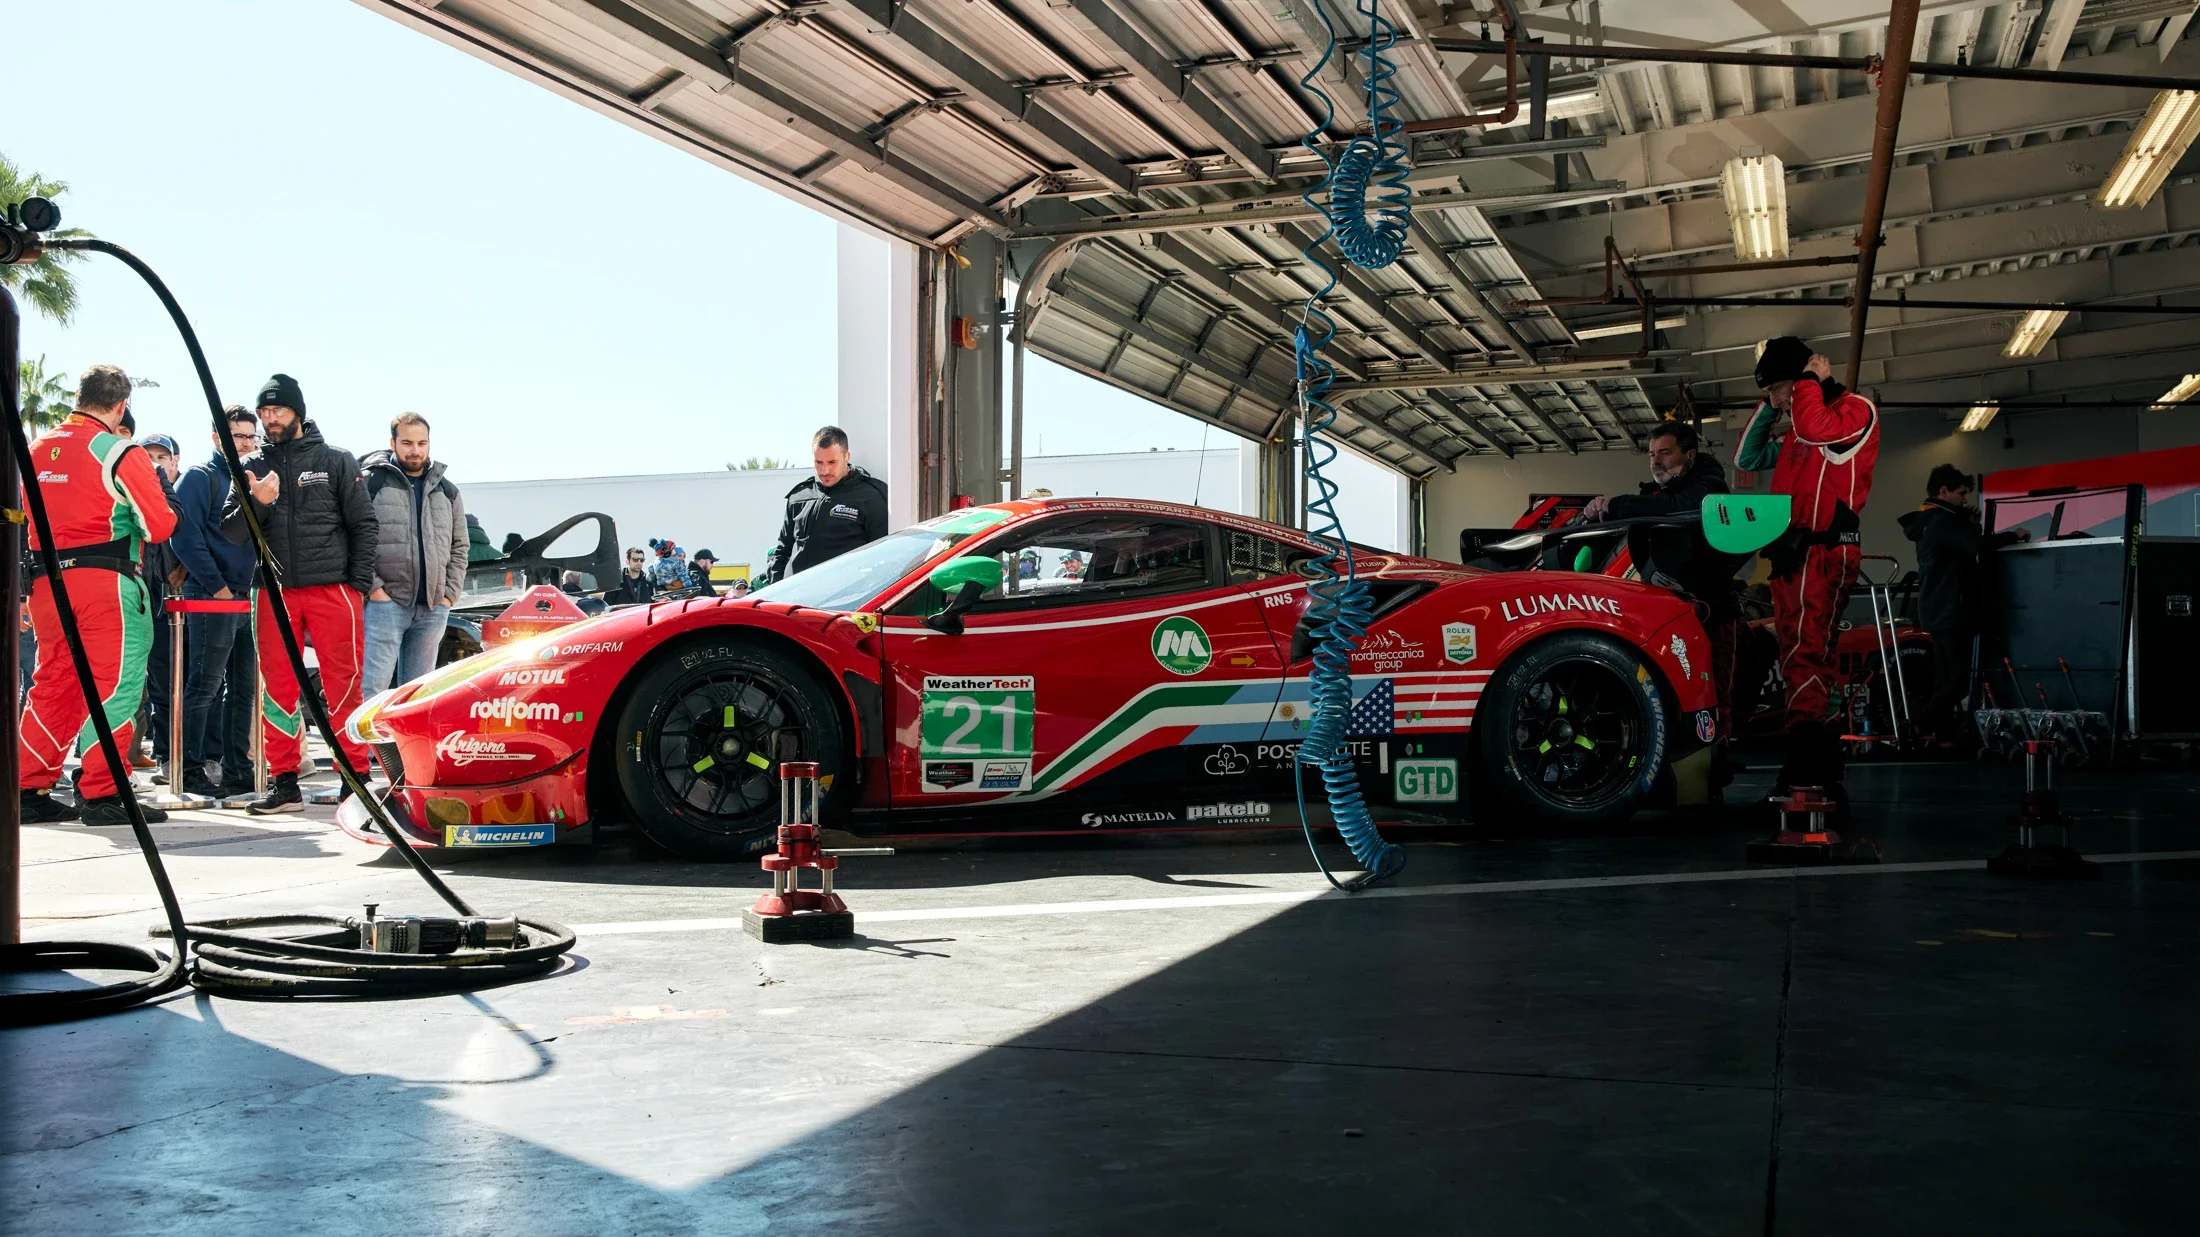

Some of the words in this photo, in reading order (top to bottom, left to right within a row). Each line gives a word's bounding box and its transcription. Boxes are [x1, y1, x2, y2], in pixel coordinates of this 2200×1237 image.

[1032, 505, 1066, 515] MANN
[1264, 592, 1293, 609] RNS
[1501, 593, 1623, 622] LUMAIKE
[561, 641, 624, 655] ORIFARM
[1448, 635, 1471, 646] 24
[1351, 648, 1424, 661] nordmeccanica
[1374, 660, 1403, 672] group
[497, 669, 567, 686] MOTUL
[470, 696, 560, 727] rotiform
[941, 695, 1016, 754] 21
[1646, 698, 1666, 786] MICHELIN
[1399, 766, 1454, 796] GTD
[1104, 802, 1177, 824] MATELDA
[1186, 801, 1271, 822] pakelo
[1217, 817, 1271, 825] LUBRICANTS
[473, 831, 545, 842] MICHELIN
